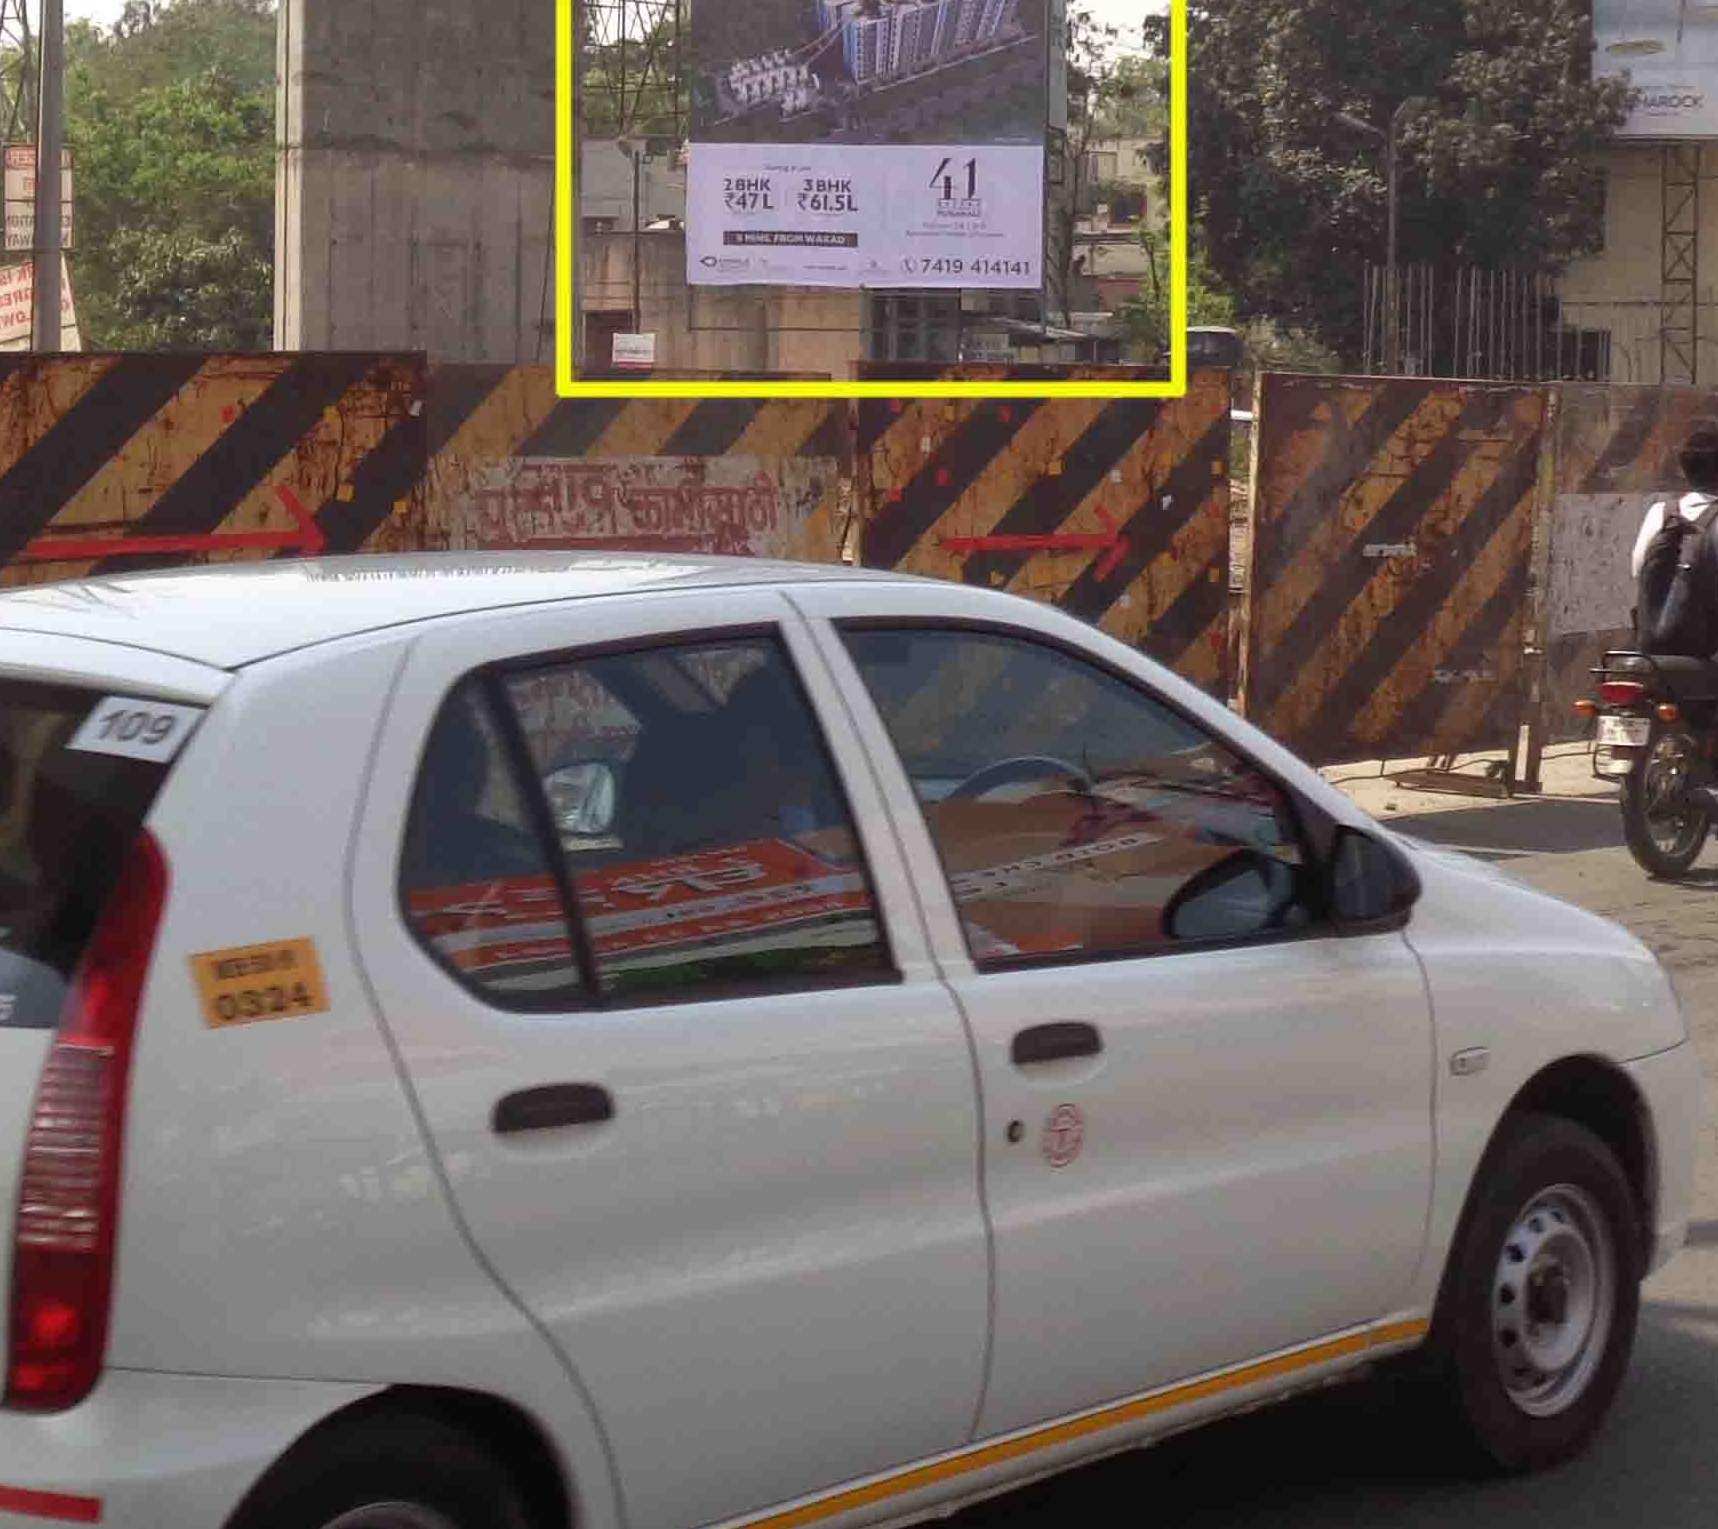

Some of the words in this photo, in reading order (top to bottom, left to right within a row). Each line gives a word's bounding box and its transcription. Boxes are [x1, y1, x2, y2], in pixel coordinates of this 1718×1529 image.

[723, 178, 732, 191] 2
[735, 178, 771, 192] BHK
[816, 179, 852, 193] BHK
[929, 156, 977, 201] 41
[921, 258, 964, 275] 7419
[970, 259, 1030, 276] 414141
[98, 709, 176, 745] 109
